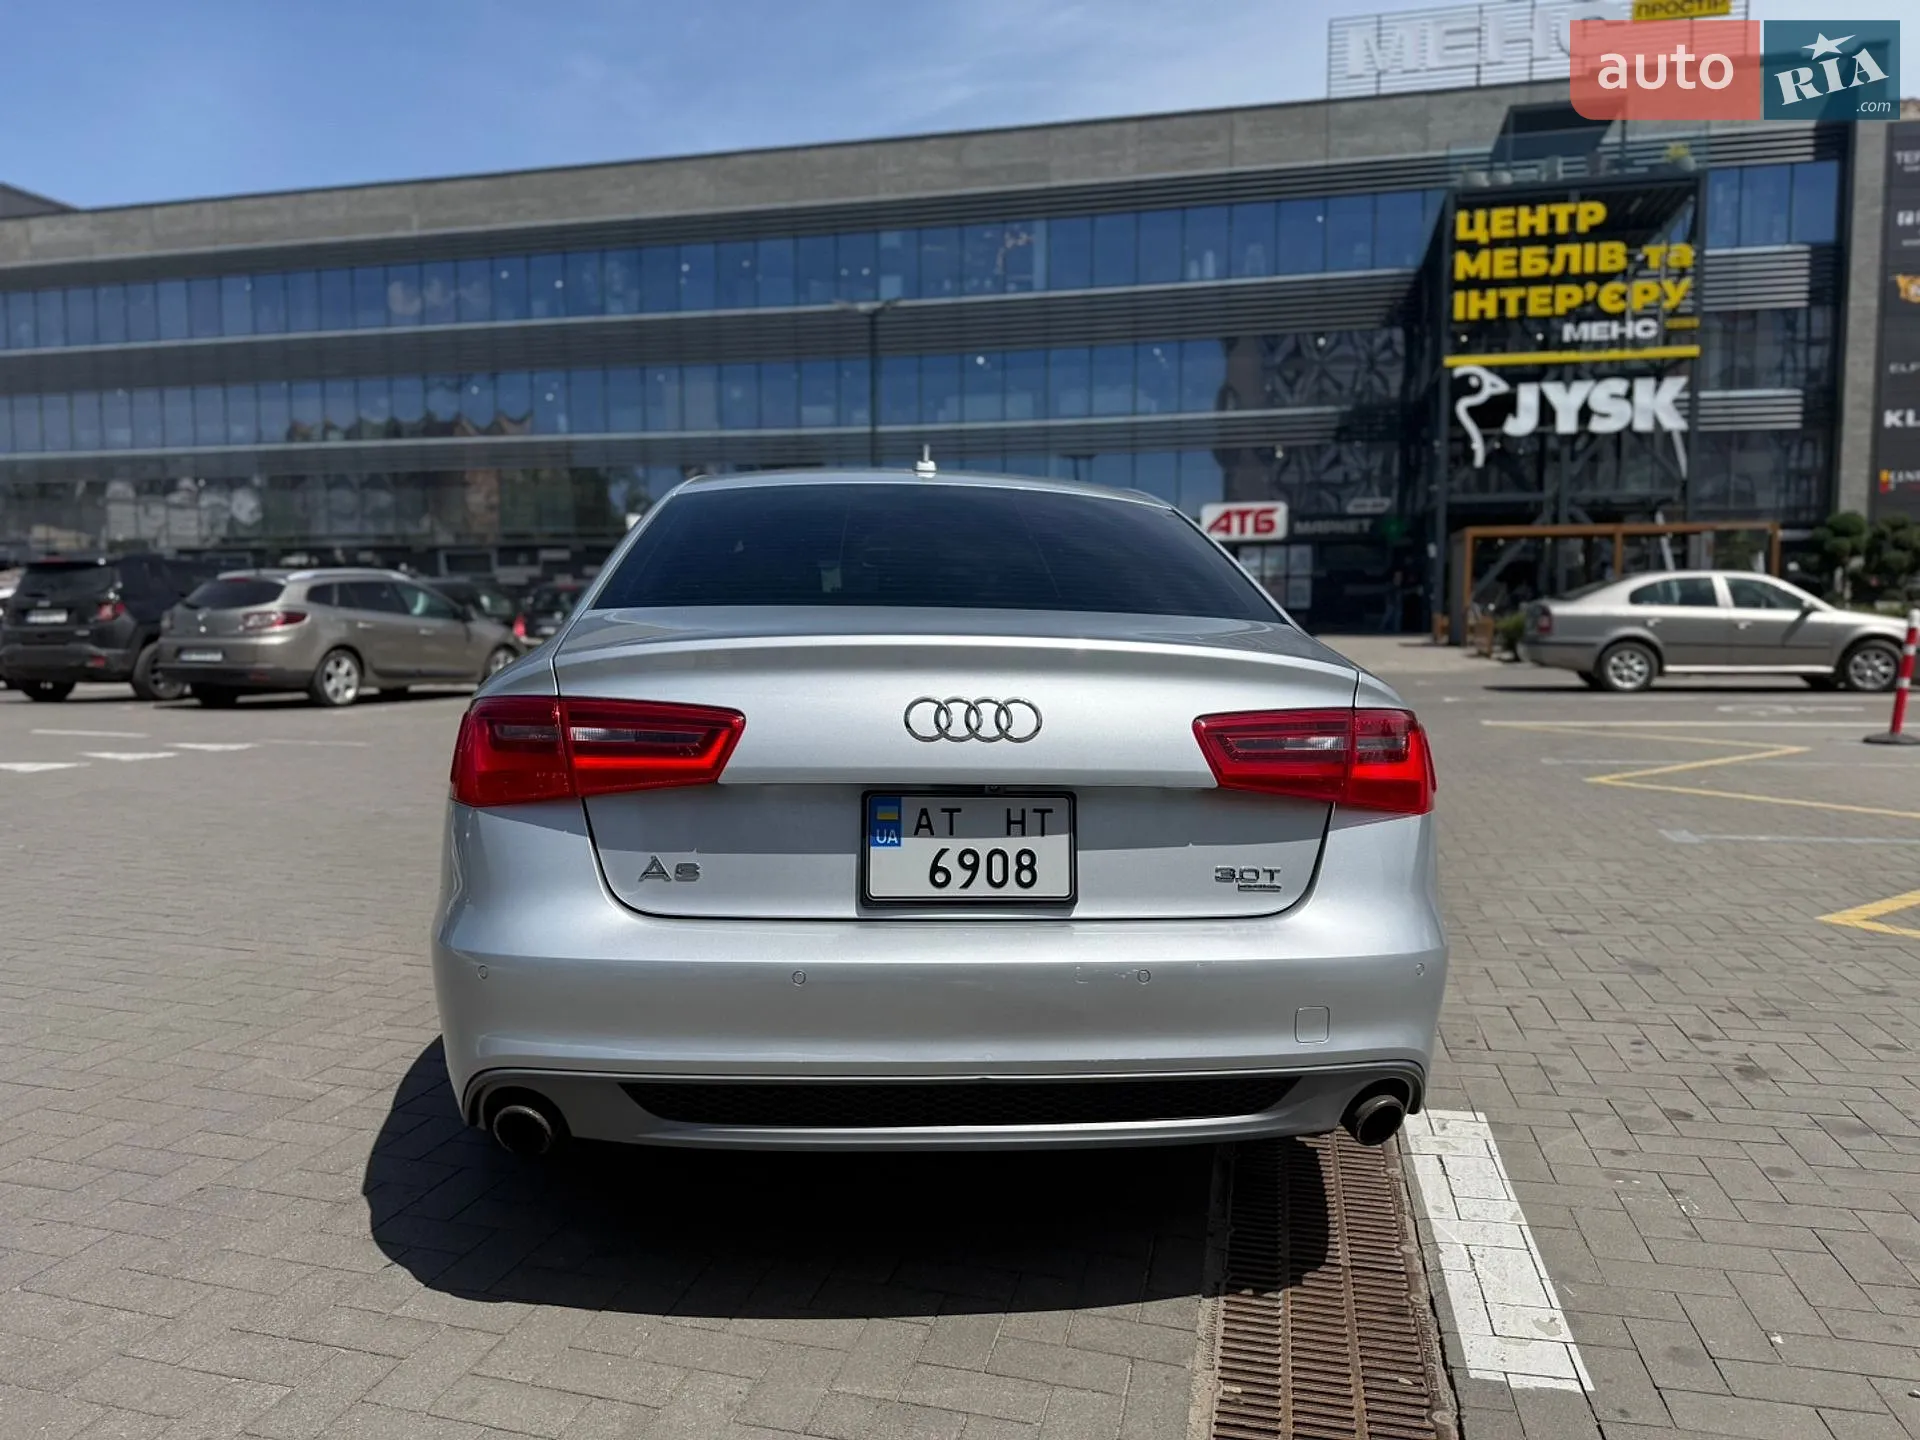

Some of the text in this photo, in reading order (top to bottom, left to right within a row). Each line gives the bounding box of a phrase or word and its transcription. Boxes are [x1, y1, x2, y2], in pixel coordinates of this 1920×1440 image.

[1455, 201, 1608, 245] ЦЕНТР
[1453, 240, 1696, 281] МЕБЛІВ та
[1452, 276, 1694, 321] ІНТЕР'ЄРУ
[1562, 317, 1660, 343] МЕНС
[1502, 375, 1690, 437] JYSK
[1207, 506, 1280, 535] АТБ
[875, 829, 899, 845] UA
[913, 807, 1054, 837] AT HT
[928, 847, 1038, 890] 6908
